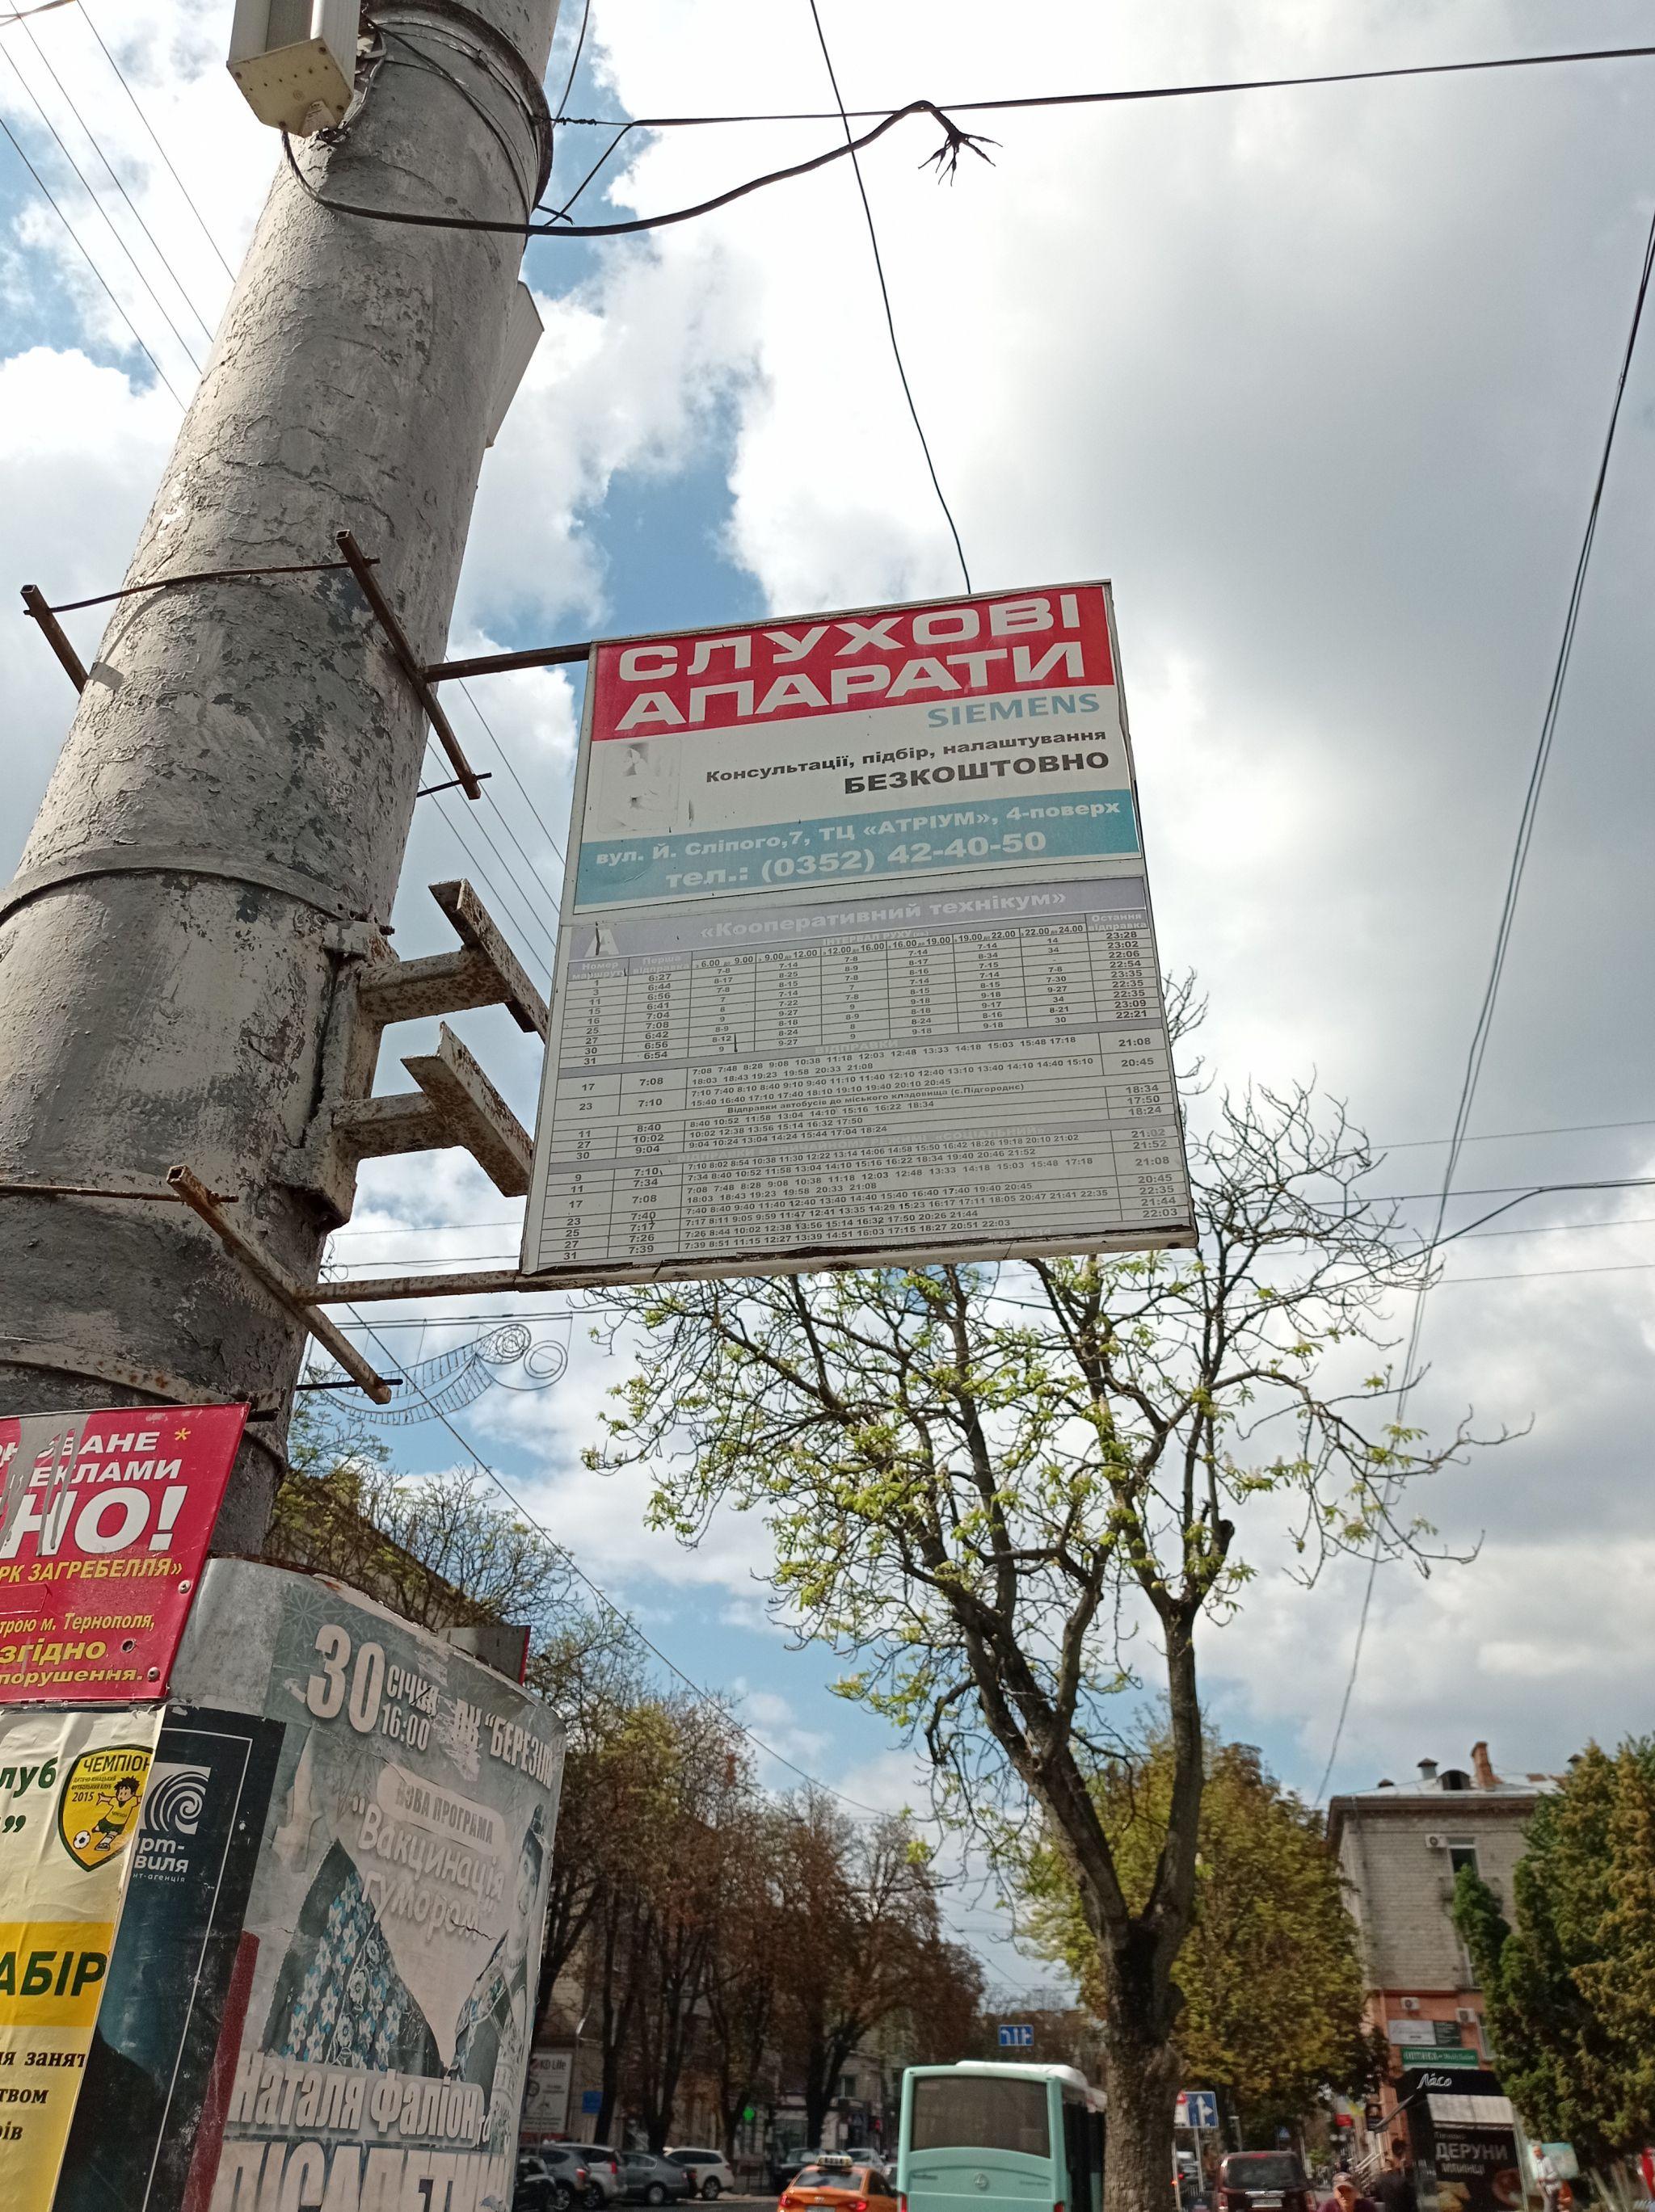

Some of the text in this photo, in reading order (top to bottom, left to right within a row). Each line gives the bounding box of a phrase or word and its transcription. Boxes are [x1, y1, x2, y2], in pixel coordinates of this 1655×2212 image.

[619, 594, 1080, 683] СЛУХОВІ
[614, 641, 1084, 730] АПАРАТИ
[928, 694, 1100, 728] SIEMENS
[706, 730, 1106, 784] Консультації, підбір, налаштування
[844, 751, 1110, 794] БЕЗКОШТОВНО
[596, 850, 643, 865] вул.
[651, 839, 677, 860] Й.
[818, 826, 855, 843] ТЦ
[862, 811, 998, 838] «АТРІУМ»,
[1006, 800, 1121, 824] 4-поверх
[666, 831, 1046, 889] тел.: (0352) 42-40-50
[701, 891, 1067, 937] «Кооперативний технікум»
[647, 982, 671, 991] 6:44
[1106, 940, 1139, 949] 23:02
[648, 973, 672, 982] 6:27
[1105, 930, 1137, 940] 23:28
[701, 924, 1083, 967] 6.00 9.00 9.00 12.00 12.00 16.00 16.00 19.00 19.00 22.00 22.00 24.00
[646, 991, 671, 1001] 6:56
[1108, 949, 1139, 959] 22:06
[646, 1001, 669, 1010] 6:41
[1109, 959, 1141, 969] 22:54
[646, 1011, 670, 1020] 7:04
[1110, 969, 1143, 978] 23:35
[584, 988, 1145, 1045] 27 6:42 22:35
[584, 999, 1147, 1054] 30 6:56 23:09
[585, 978, 1143, 1034] 25 7:08 22:35
[583, 1009, 1147, 1065] 31 6:54 22:21
[579, 1057, 1154, 1111] 23 7:10 20:45
[581, 1037, 1151, 1091] 17 7:08 21:08
[576, 1095, 1160, 1149] 27 10:02 17:50
[576, 1105, 1161, 1159] 30 9:04 18:24
[578, 1083, 1159, 1138] 11 8:40 18:34
[570, 1139, 1168, 1192] 11 7:34 21:52
[634, 1167, 659, 1176] 7:10
[1131, 1128, 1165, 1138] 21:02
[566, 1173, 1172, 1226] 23 7:40 20:45
[568, 1155, 1169, 1209] 17 7:08 21:08
[563, 1196, 1176, 1249] 27 7:26 21:44
[563, 1208, 1177, 1260] 31 7:39 22:03
[565, 1184, 1174, 1238] 25 7:17 22:35
[10, 1458, 183, 1490] ЕКЛАМИ
[27, 1558, 183, 1582] ЗАГРЕБЕЛЛЯ»
[63, 1612, 156, 1634] Тернополя,
[307, 1624, 385, 1734] 30
[381, 1702, 432, 1752] 16:00
[72, 1792, 95, 1802] 2015
